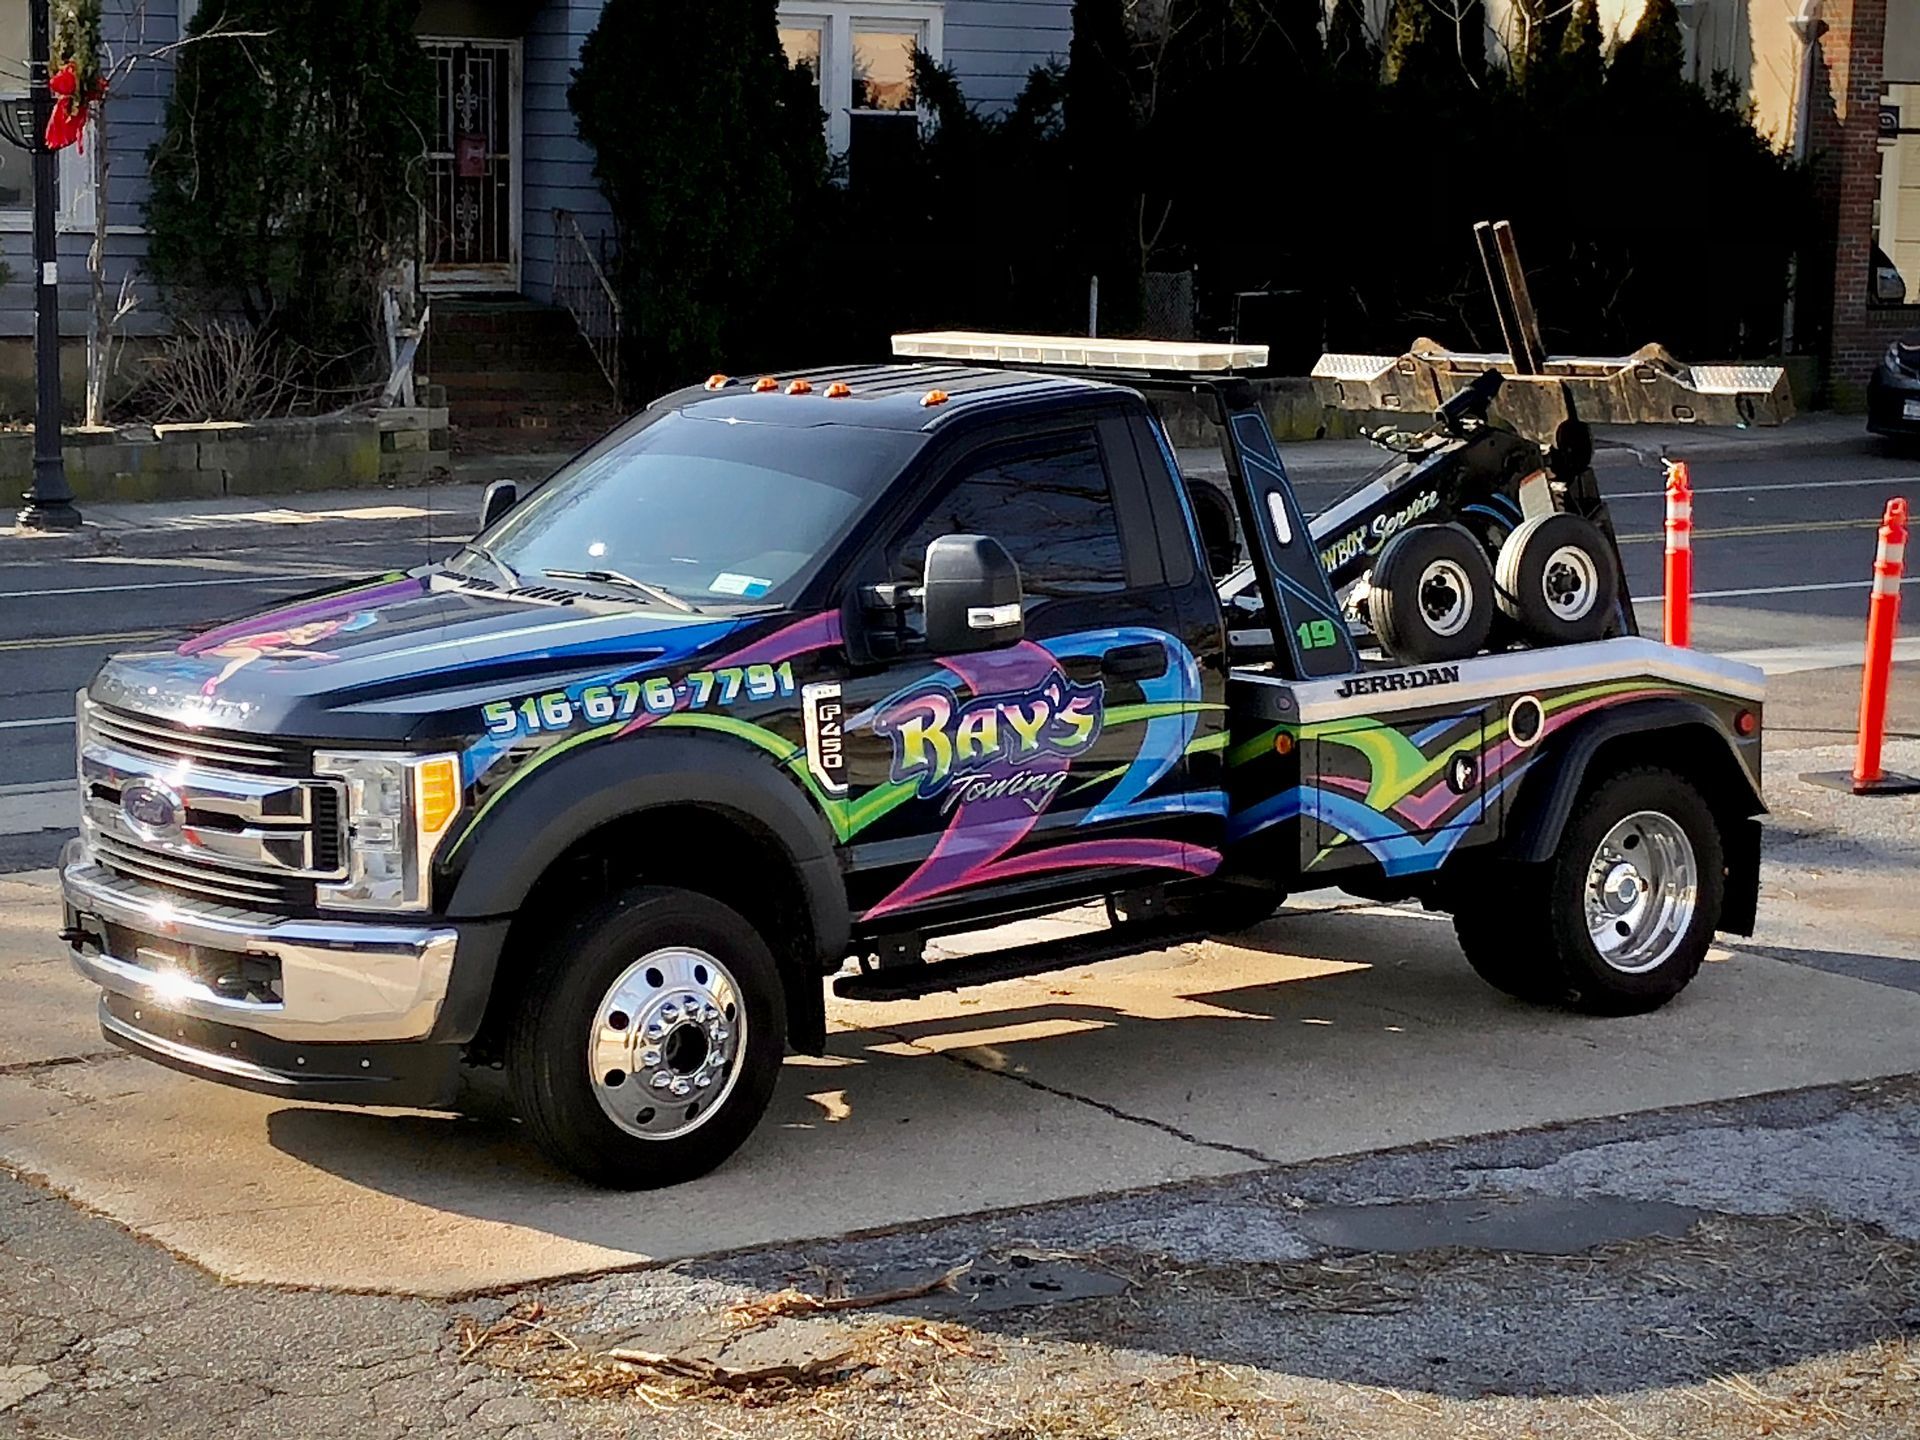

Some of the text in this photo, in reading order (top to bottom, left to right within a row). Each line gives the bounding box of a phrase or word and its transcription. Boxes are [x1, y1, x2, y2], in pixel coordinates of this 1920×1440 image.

[1320, 490, 1440, 573] WBOY Service
[1296, 619, 1337, 649] 19
[482, 661, 795, 738] 516-676-7791
[1335, 665, 1460, 697] JERR-DAN
[939, 770, 1068, 815] Towing
